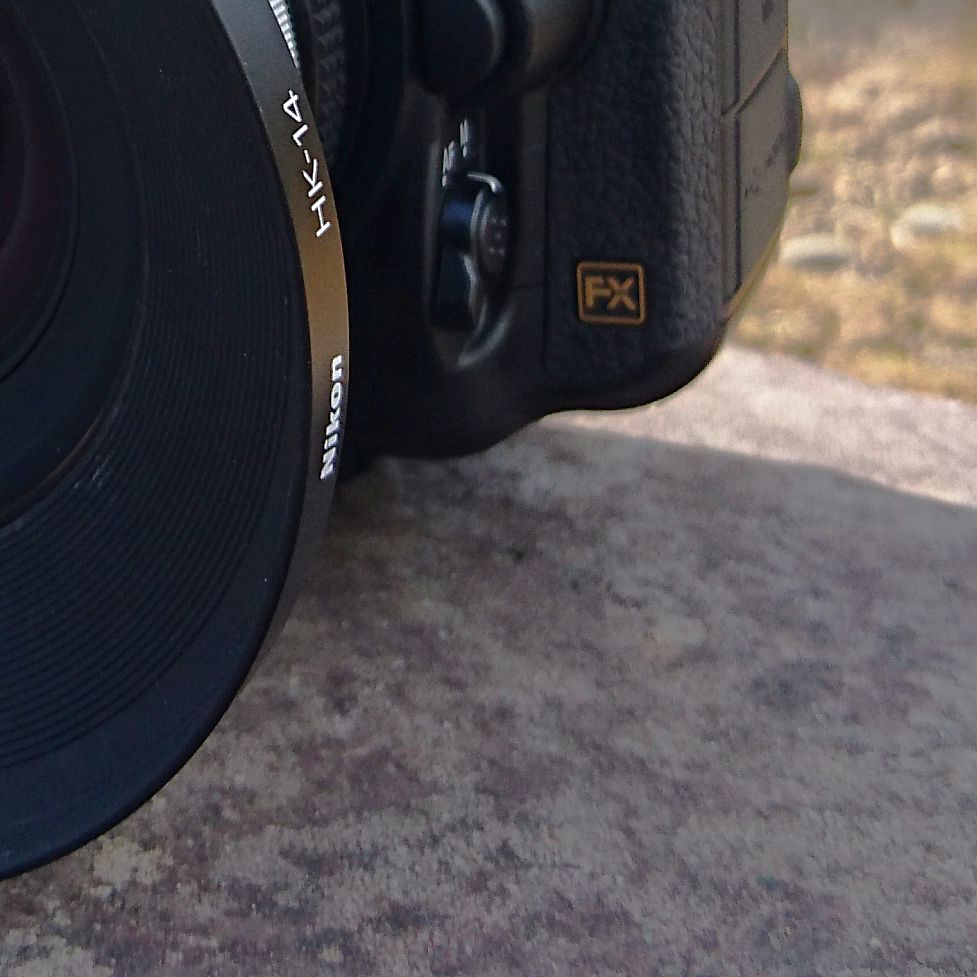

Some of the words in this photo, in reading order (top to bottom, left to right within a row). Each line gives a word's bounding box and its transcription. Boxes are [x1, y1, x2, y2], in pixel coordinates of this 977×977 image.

[283, 89, 331, 237] HK-14
[584, 275, 637, 311] FX
[320, 355, 343, 480] Nikon
